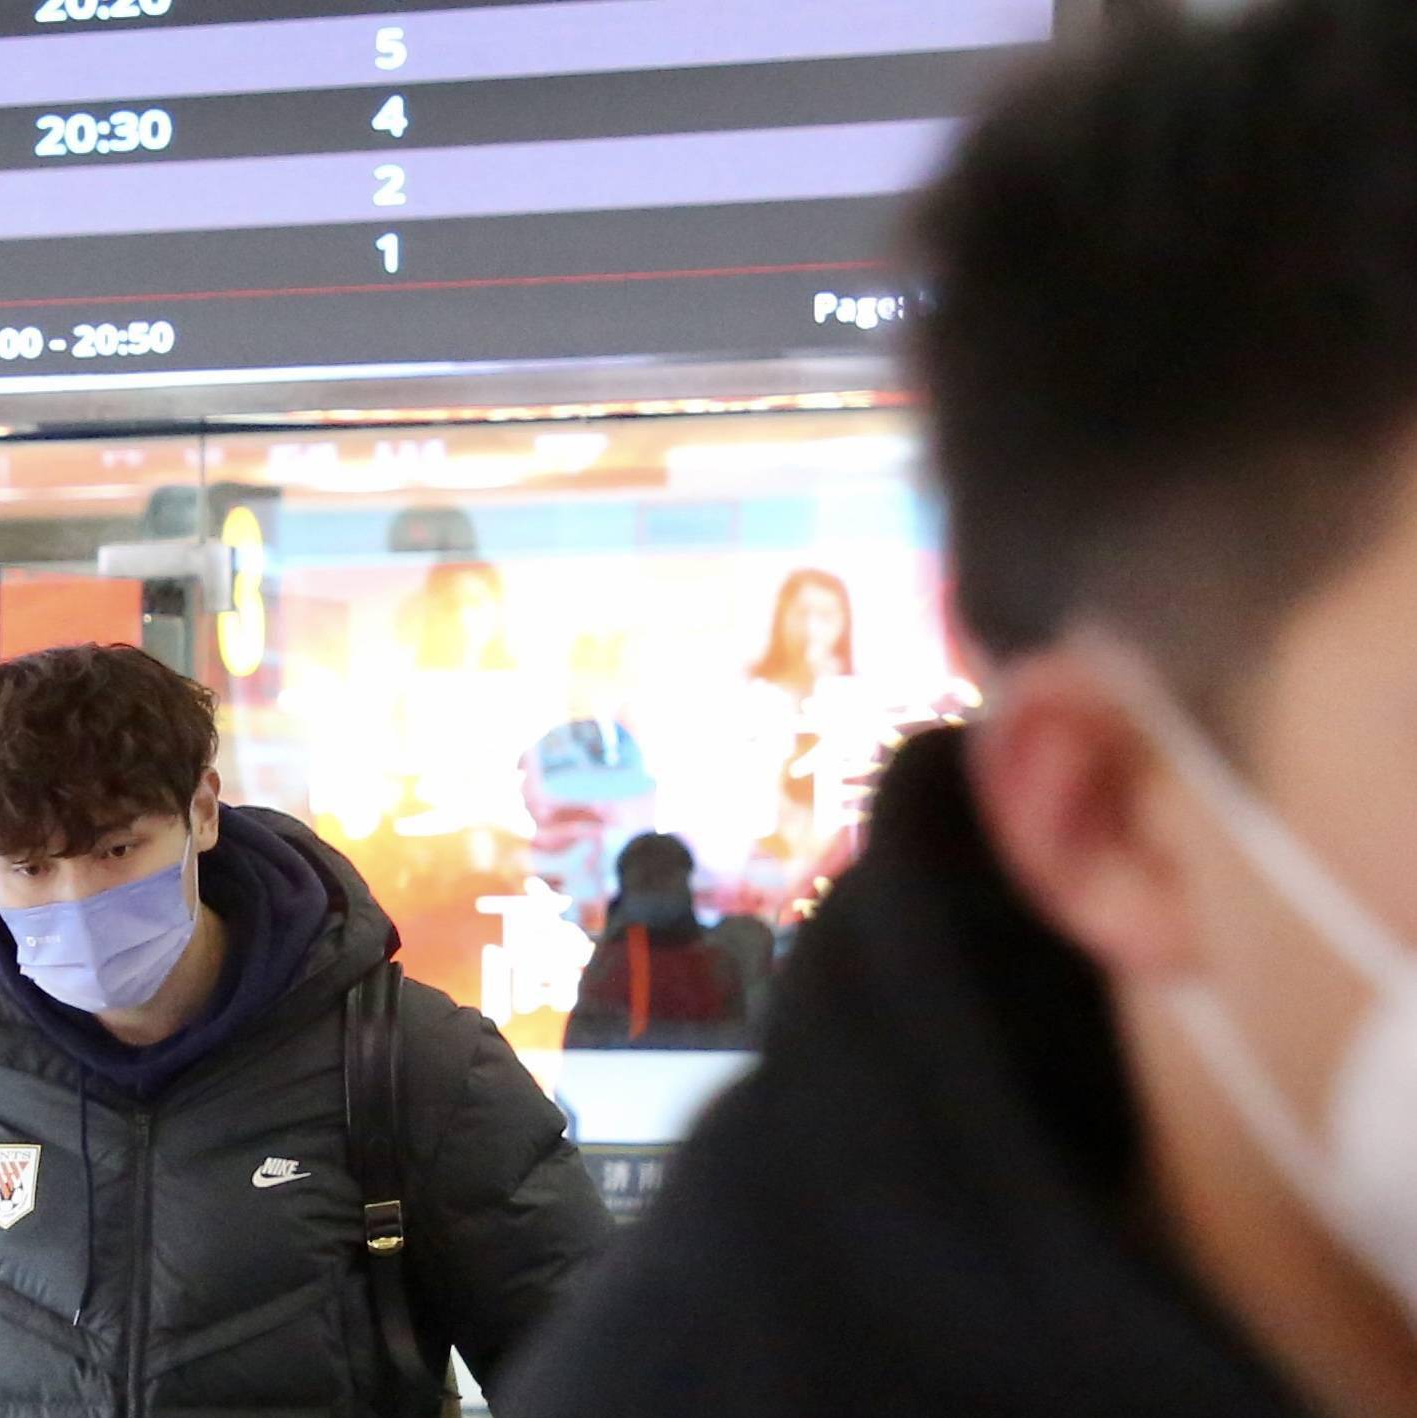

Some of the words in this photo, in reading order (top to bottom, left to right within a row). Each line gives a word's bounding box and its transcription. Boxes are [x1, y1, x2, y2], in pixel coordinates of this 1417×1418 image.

[377, 30, 406, 68] 5
[36, 110, 171, 155] 20:30
[373, 96, 407, 136] 4
[374, 168, 405, 205] 2
[377, 234, 397, 272] 1
[72, 322, 174, 357] 20:50
[262, 1157, 300, 1177] NIKE
